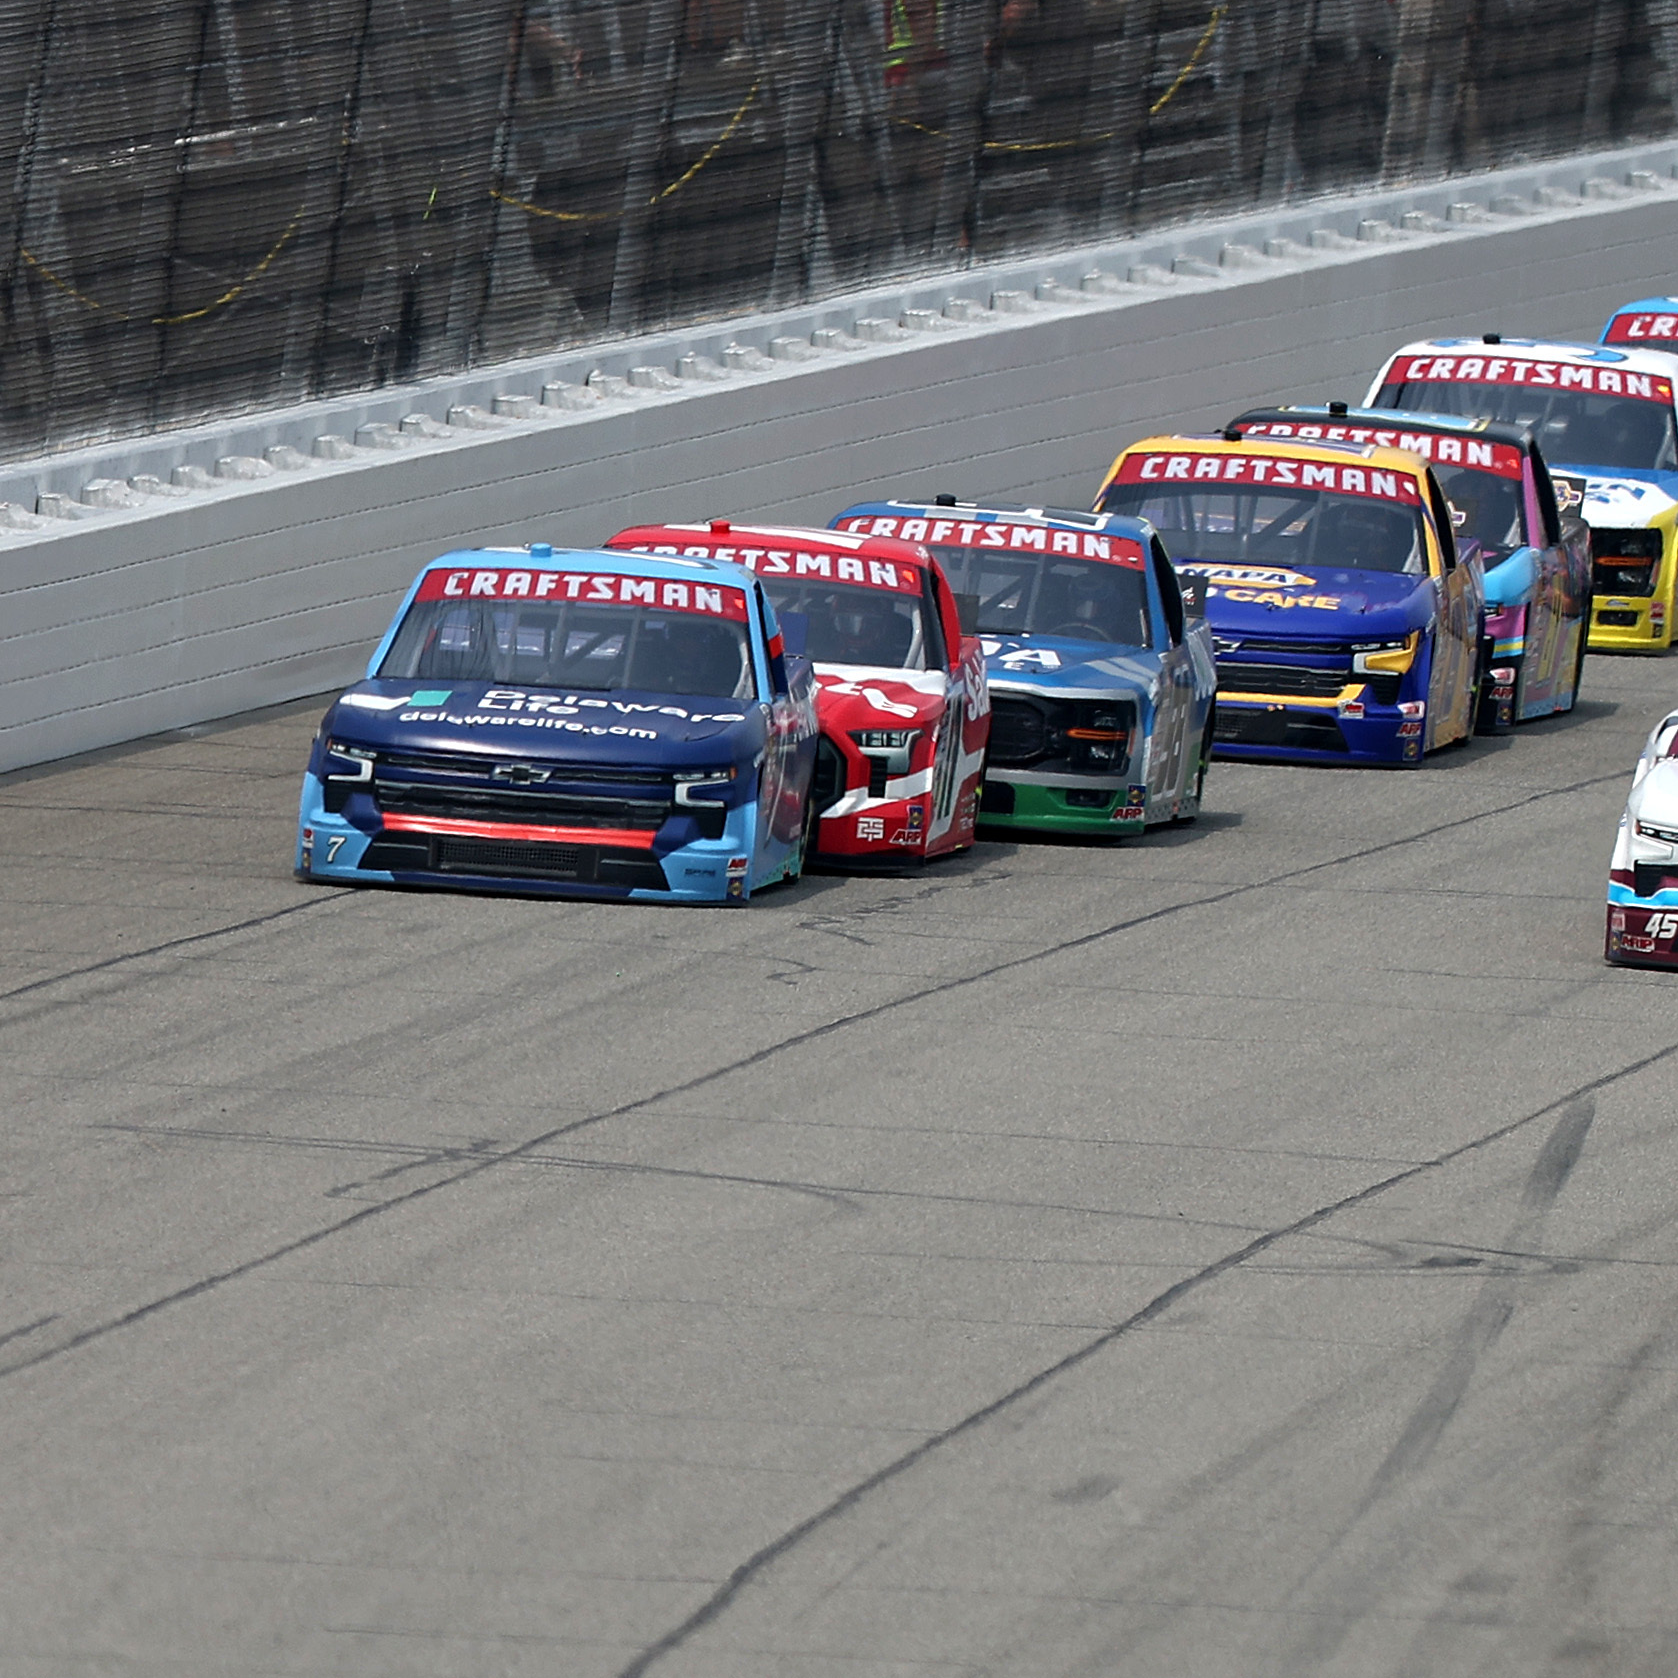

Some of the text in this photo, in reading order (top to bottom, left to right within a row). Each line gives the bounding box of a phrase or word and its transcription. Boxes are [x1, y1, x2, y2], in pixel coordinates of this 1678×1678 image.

[1405, 357, 1654, 399] CRAFTSMAN
[1139, 456, 1398, 498] CRAFTSMAN
[848, 517, 1112, 560] CRAFTSMAN
[444, 571, 723, 614] CRAFTSMAN
[1182, 568, 1289, 584] NAPA
[1225, 589, 1342, 610] CARE
[476, 697, 580, 715] Life
[483, 689, 746, 724] Delaware
[326, 835, 348, 864] 7
